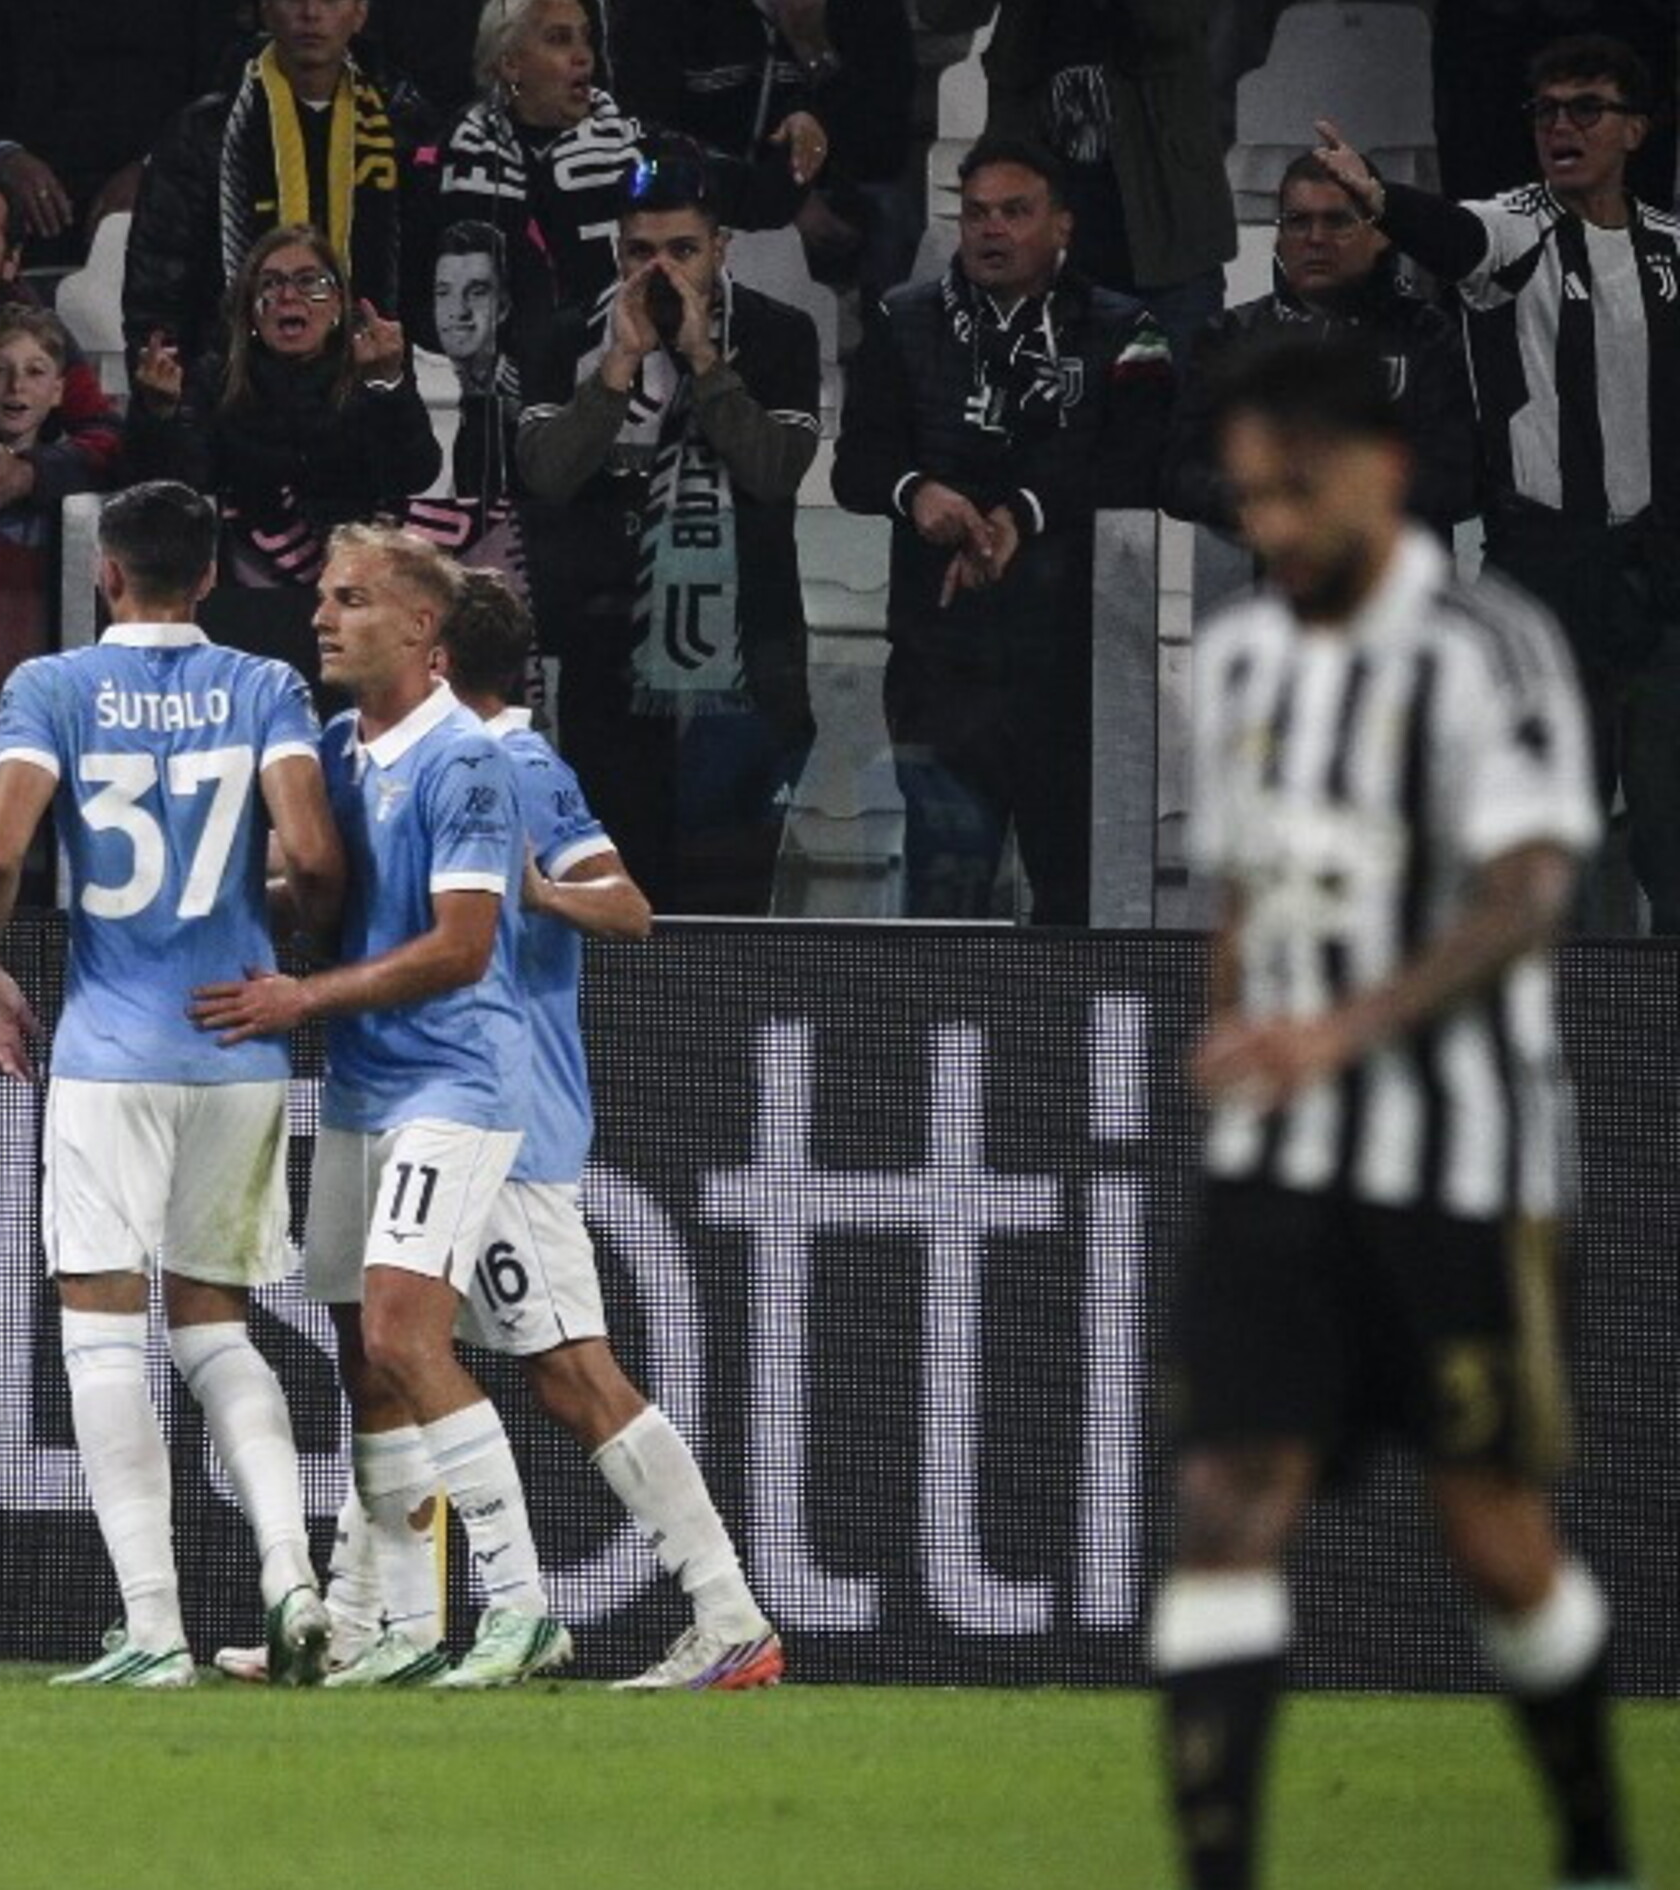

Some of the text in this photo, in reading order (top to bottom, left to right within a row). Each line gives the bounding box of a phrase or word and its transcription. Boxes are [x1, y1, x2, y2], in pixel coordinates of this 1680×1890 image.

[96, 678, 230, 731] ŠUTALO
[79, 744, 254, 920] 37
[390, 1162, 439, 1225] 11
[475, 1239, 529, 1312] 16
